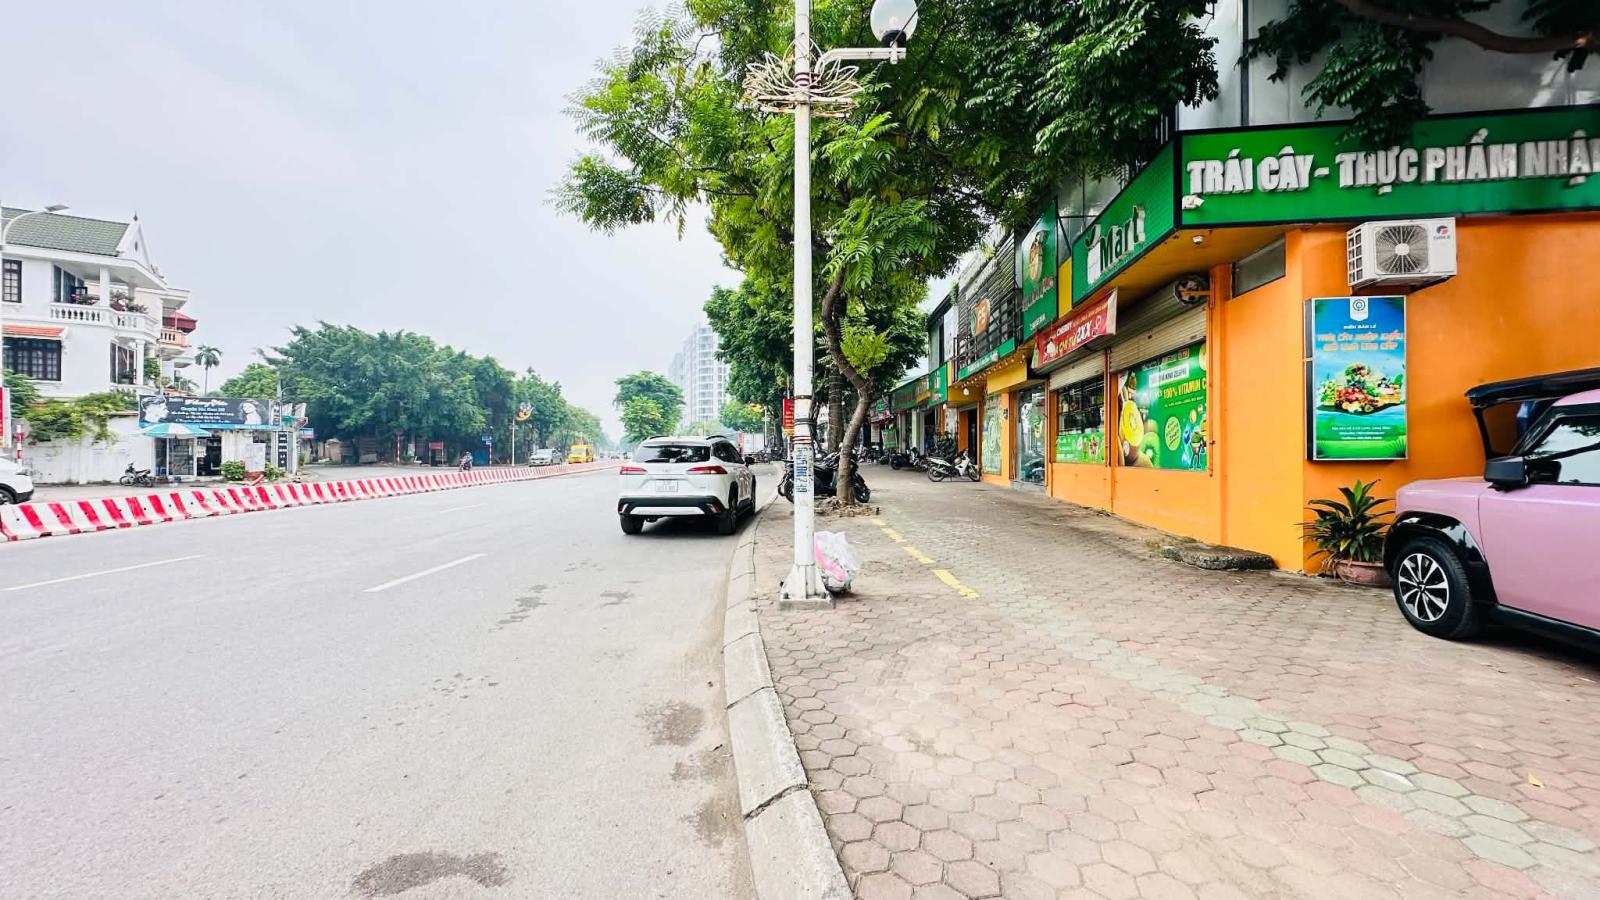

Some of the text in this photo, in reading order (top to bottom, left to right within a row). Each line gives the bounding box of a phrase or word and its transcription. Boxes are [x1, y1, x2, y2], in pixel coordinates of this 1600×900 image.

[1187, 148, 1253, 195] TRÁI
[1256, 145, 1315, 192] CÂY
[1335, 145, 1419, 195] THỰC
[1421, 128, 1519, 184] PHẨM
[1100, 204, 1146, 273] Mart
[1178, 378, 1201, 396] VITAMIN
